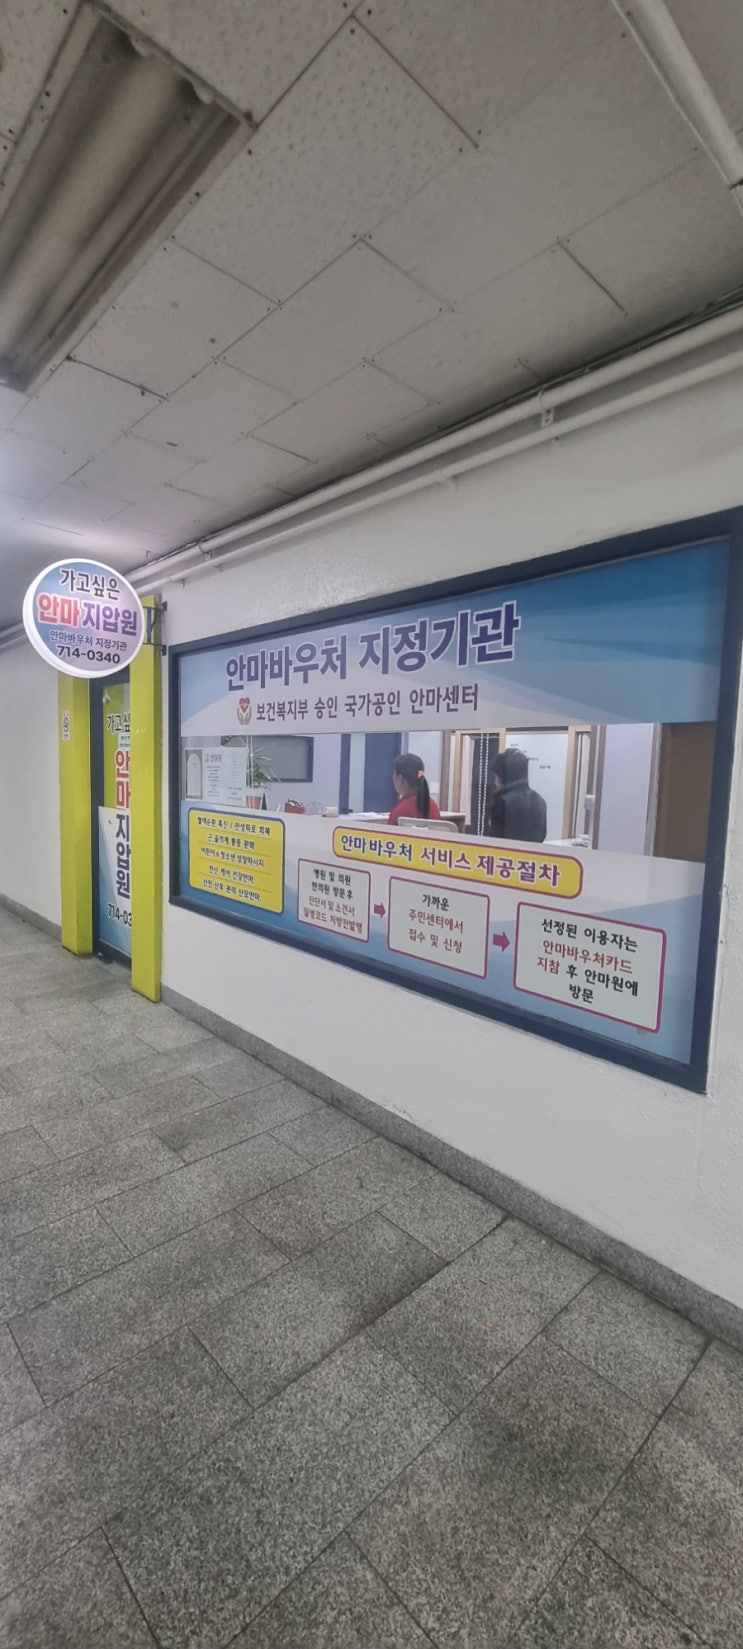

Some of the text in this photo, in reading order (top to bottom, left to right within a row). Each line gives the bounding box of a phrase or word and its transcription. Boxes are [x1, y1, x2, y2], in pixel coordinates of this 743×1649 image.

[60, 570, 120, 600] 가고싶은
[50, 631, 127, 651] 안마바우처 지정기관
[226, 603, 520, 691] 안마바우처 지정기관
[57, 645, 120, 664] 714-0340
[256, 683, 478, 721] 보건복지부 승인 국가공인 안마센터
[341, 835, 560, 886] 안마바우처 서비스 제공절차
[312, 881, 330, 895] 한의원
[314, 868, 351, 886] 병원 및 의원
[422, 894, 449, 911] 가까운
[304, 907, 362, 934] 질병코드 처방전발행
[409, 909, 463, 934] 주민센터에서
[409, 928, 462, 954] 접수 및 신청
[541, 918, 638, 952] 선정된 이용자는
[543, 940, 633, 974] 안마바우처카드
[537, 957, 638, 997] 지참 후 안마원에
[569, 984, 594, 1003] 방문
